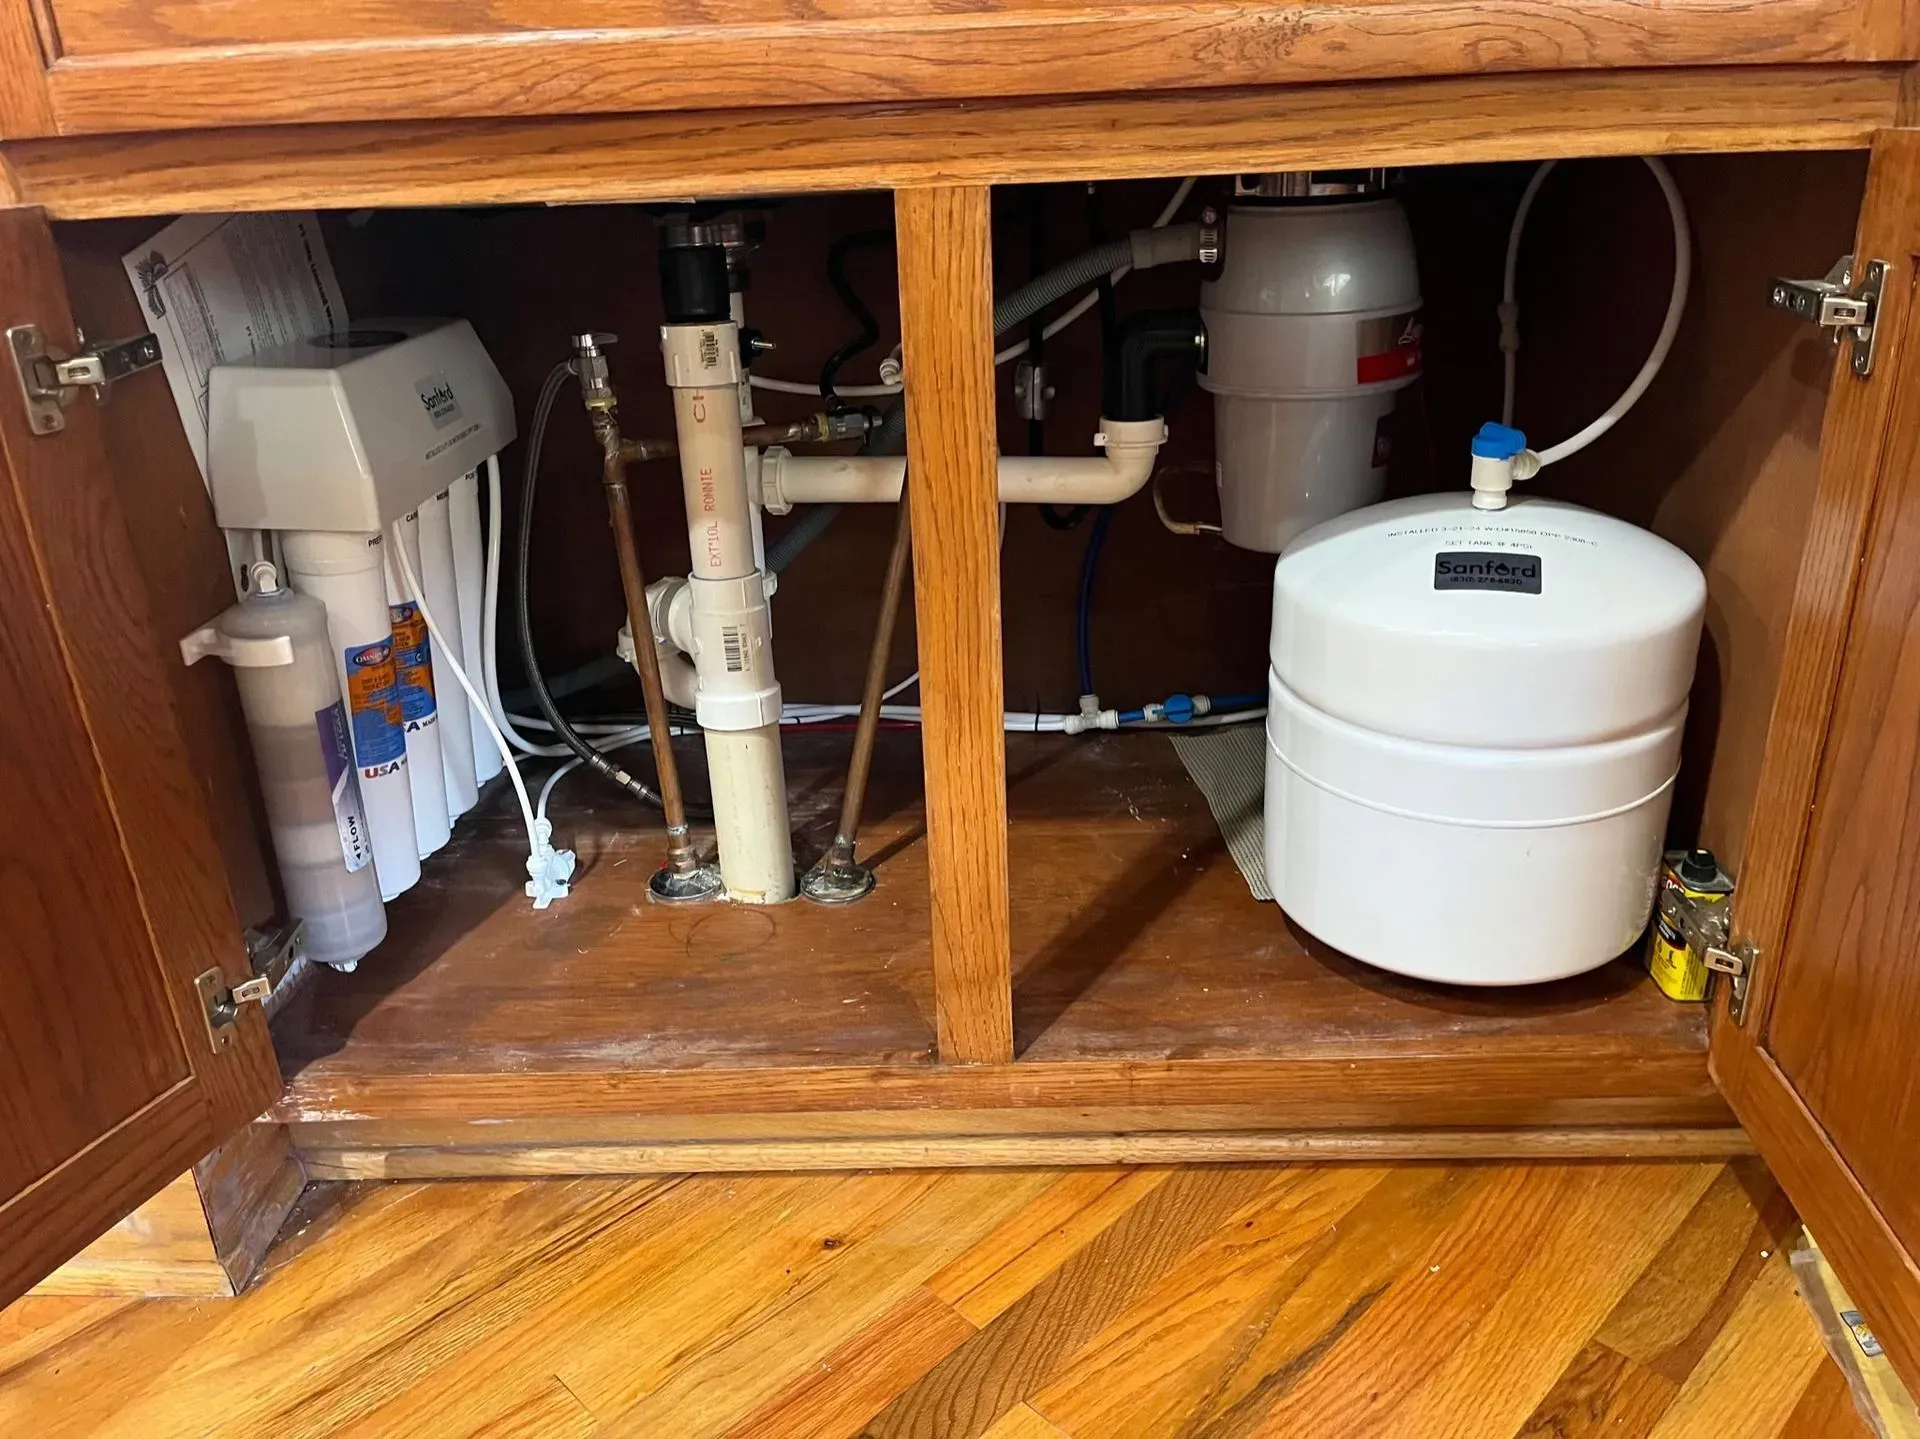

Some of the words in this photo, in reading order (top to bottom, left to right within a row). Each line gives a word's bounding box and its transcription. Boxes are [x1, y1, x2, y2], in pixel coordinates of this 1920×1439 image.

[421, 381, 454, 411] Sanford
[700, 468, 715, 511] RONNIE
[1438, 561, 1536, 578] Sanford
[364, 761, 400, 779] USA
[347, 816, 361, 851] FLOW
